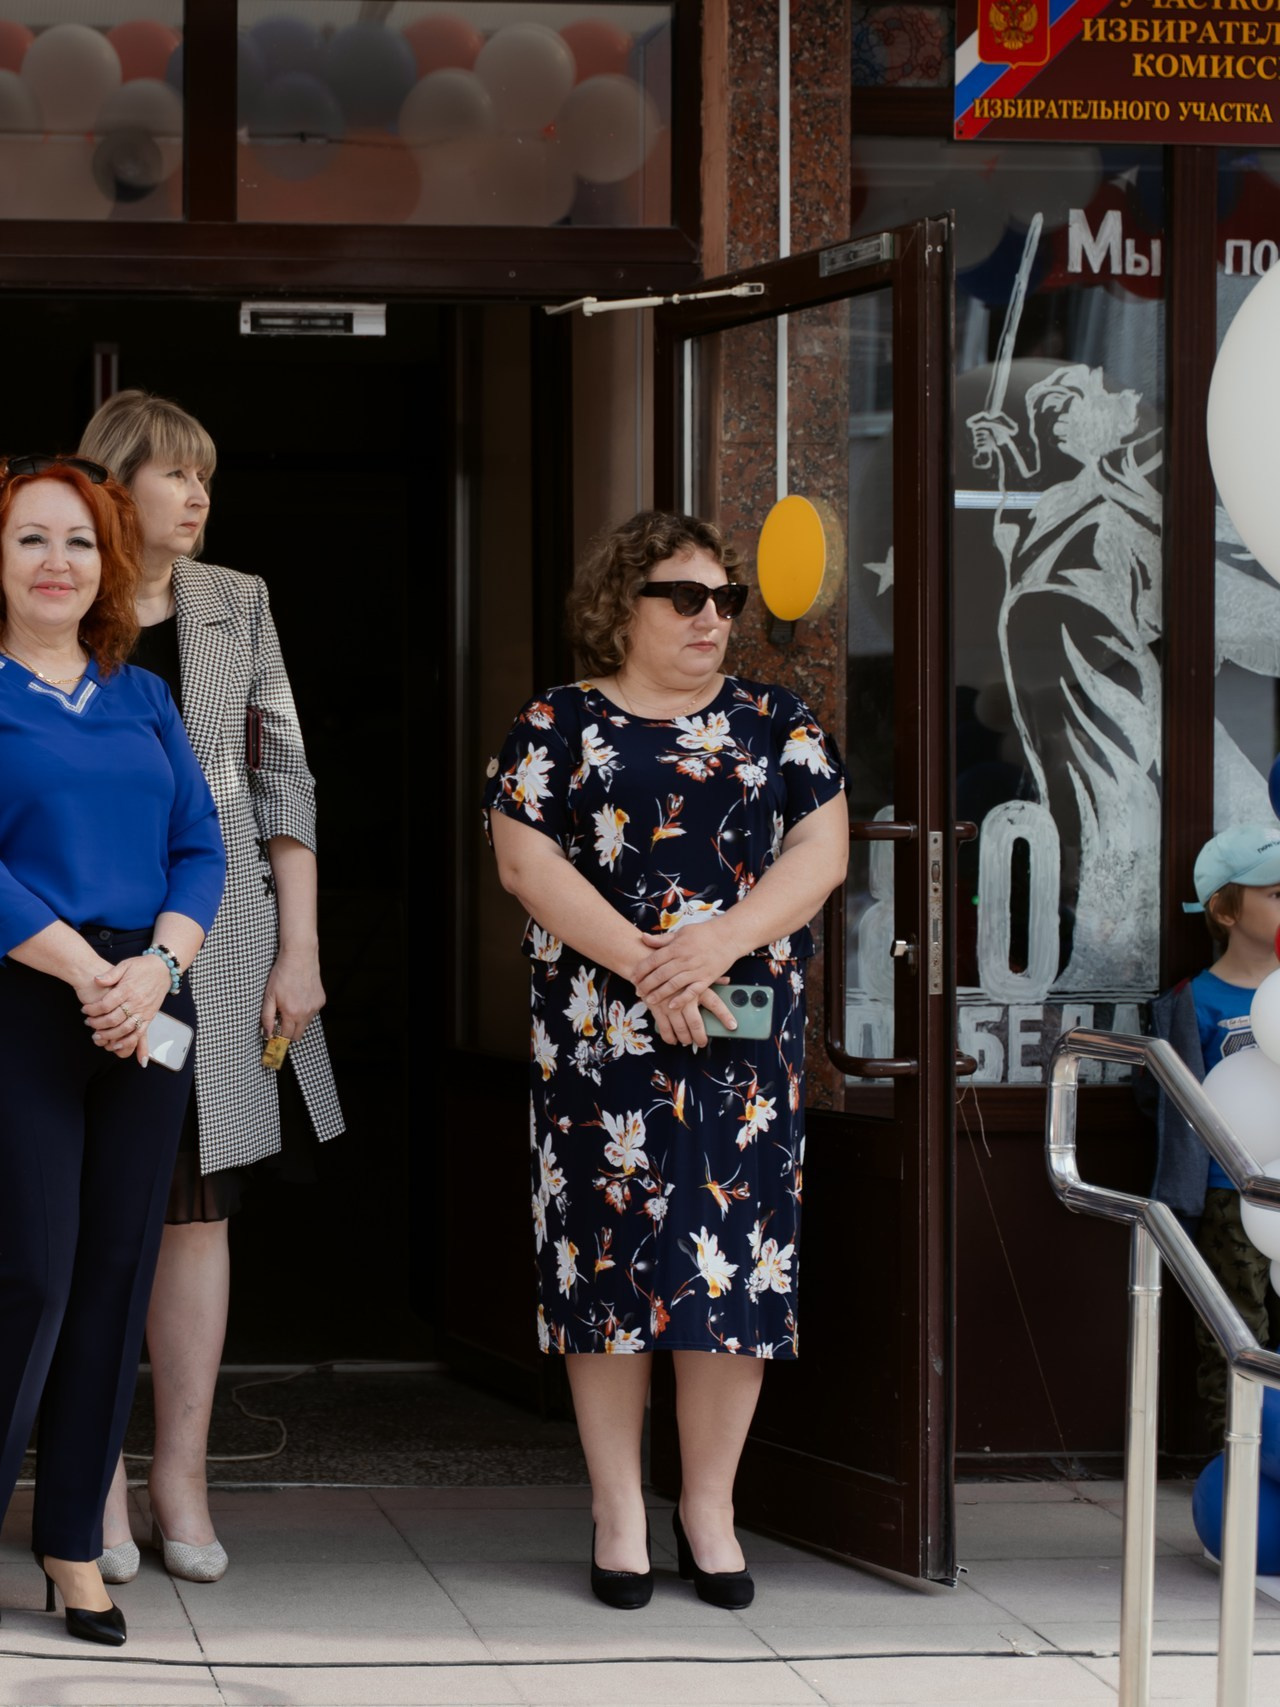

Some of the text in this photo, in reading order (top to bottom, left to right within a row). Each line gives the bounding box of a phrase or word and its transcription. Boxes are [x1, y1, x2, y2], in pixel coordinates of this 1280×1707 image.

[1131, 52, 1280, 80] КОМИСС
[972, 98, 1273, 123] ИЗБИРАТЕЛЬНОГО УЧАСТКА
[1068, 208, 1161, 278] Мы
